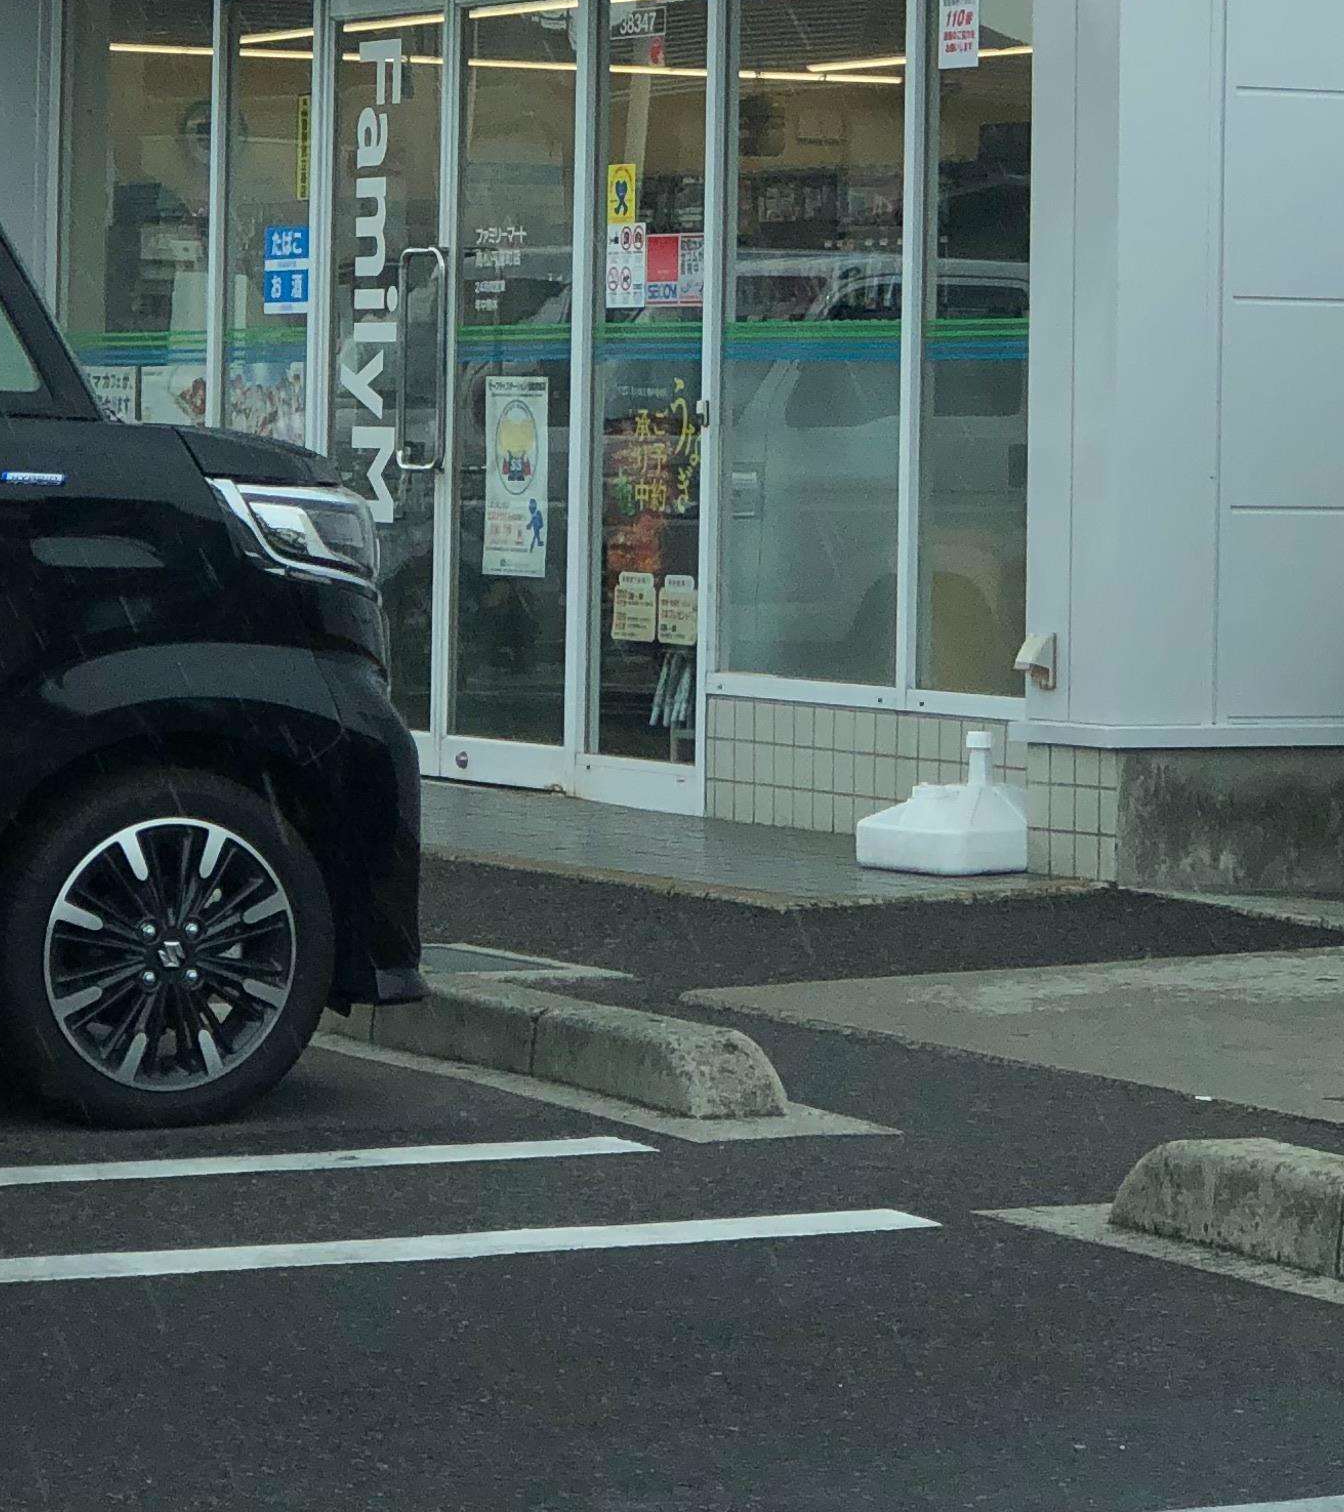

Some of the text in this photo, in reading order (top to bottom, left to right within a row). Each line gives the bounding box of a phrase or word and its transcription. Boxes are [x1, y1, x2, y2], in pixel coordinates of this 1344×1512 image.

[619, 11, 657, 35] 38347
[271, 231, 303, 256] たばこ
[475, 225, 528, 245] ファミリーマート
